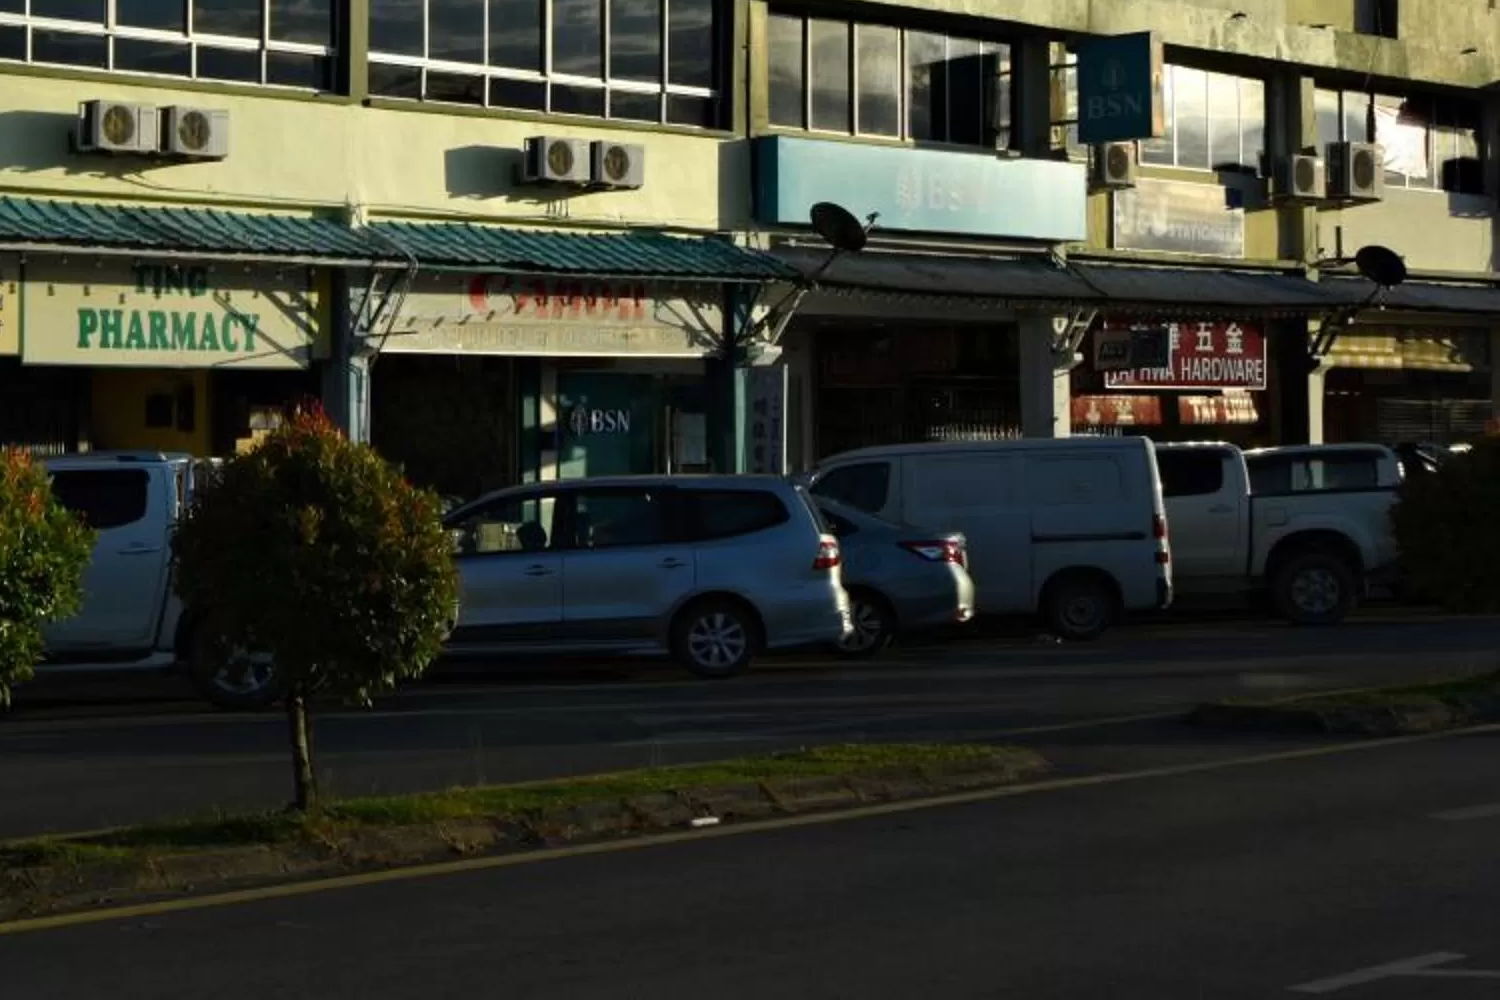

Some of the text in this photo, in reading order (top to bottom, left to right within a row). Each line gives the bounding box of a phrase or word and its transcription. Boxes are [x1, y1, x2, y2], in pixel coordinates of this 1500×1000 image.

[1087, 93, 1143, 119] BSN
[132, 264, 206, 295] TING
[78, 308, 259, 352] PHARMACY
[1181, 356, 1264, 382] HARDWARE
[591, 409, 631, 432] BSN
